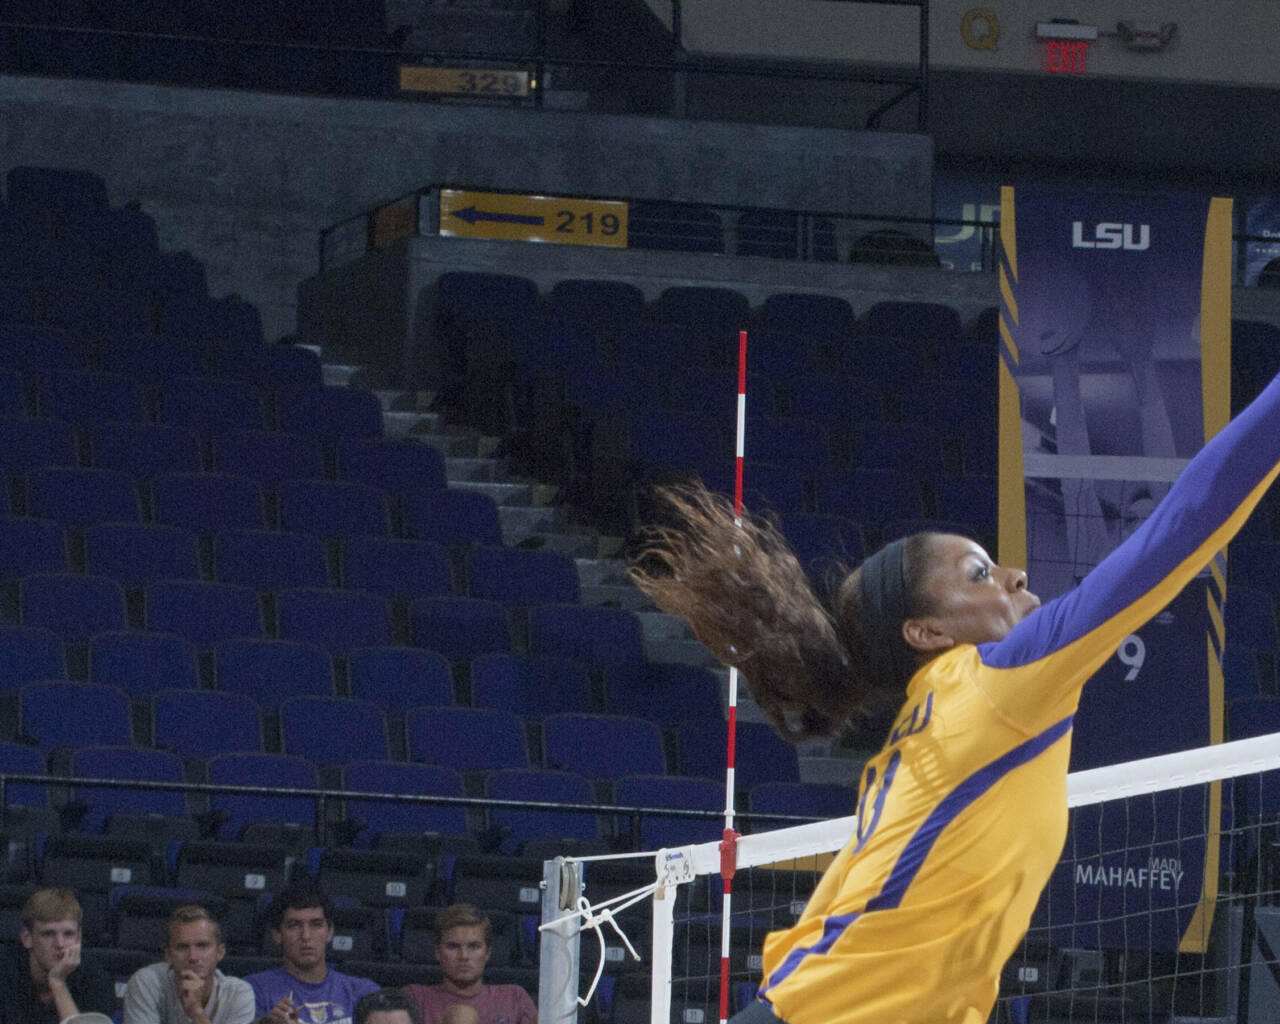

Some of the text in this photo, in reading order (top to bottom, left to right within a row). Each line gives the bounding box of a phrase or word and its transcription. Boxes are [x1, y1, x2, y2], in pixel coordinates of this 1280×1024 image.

[960, 9, 1000, 52] Q
[1048, 41, 1087, 73] EXIT
[555, 211, 620, 237] 219
[1073, 221, 1150, 251] LSU
[1117, 634, 1146, 681] 9
[1075, 863, 1185, 890] MAHAFFEY
[1148, 859, 1182, 872] MADI
